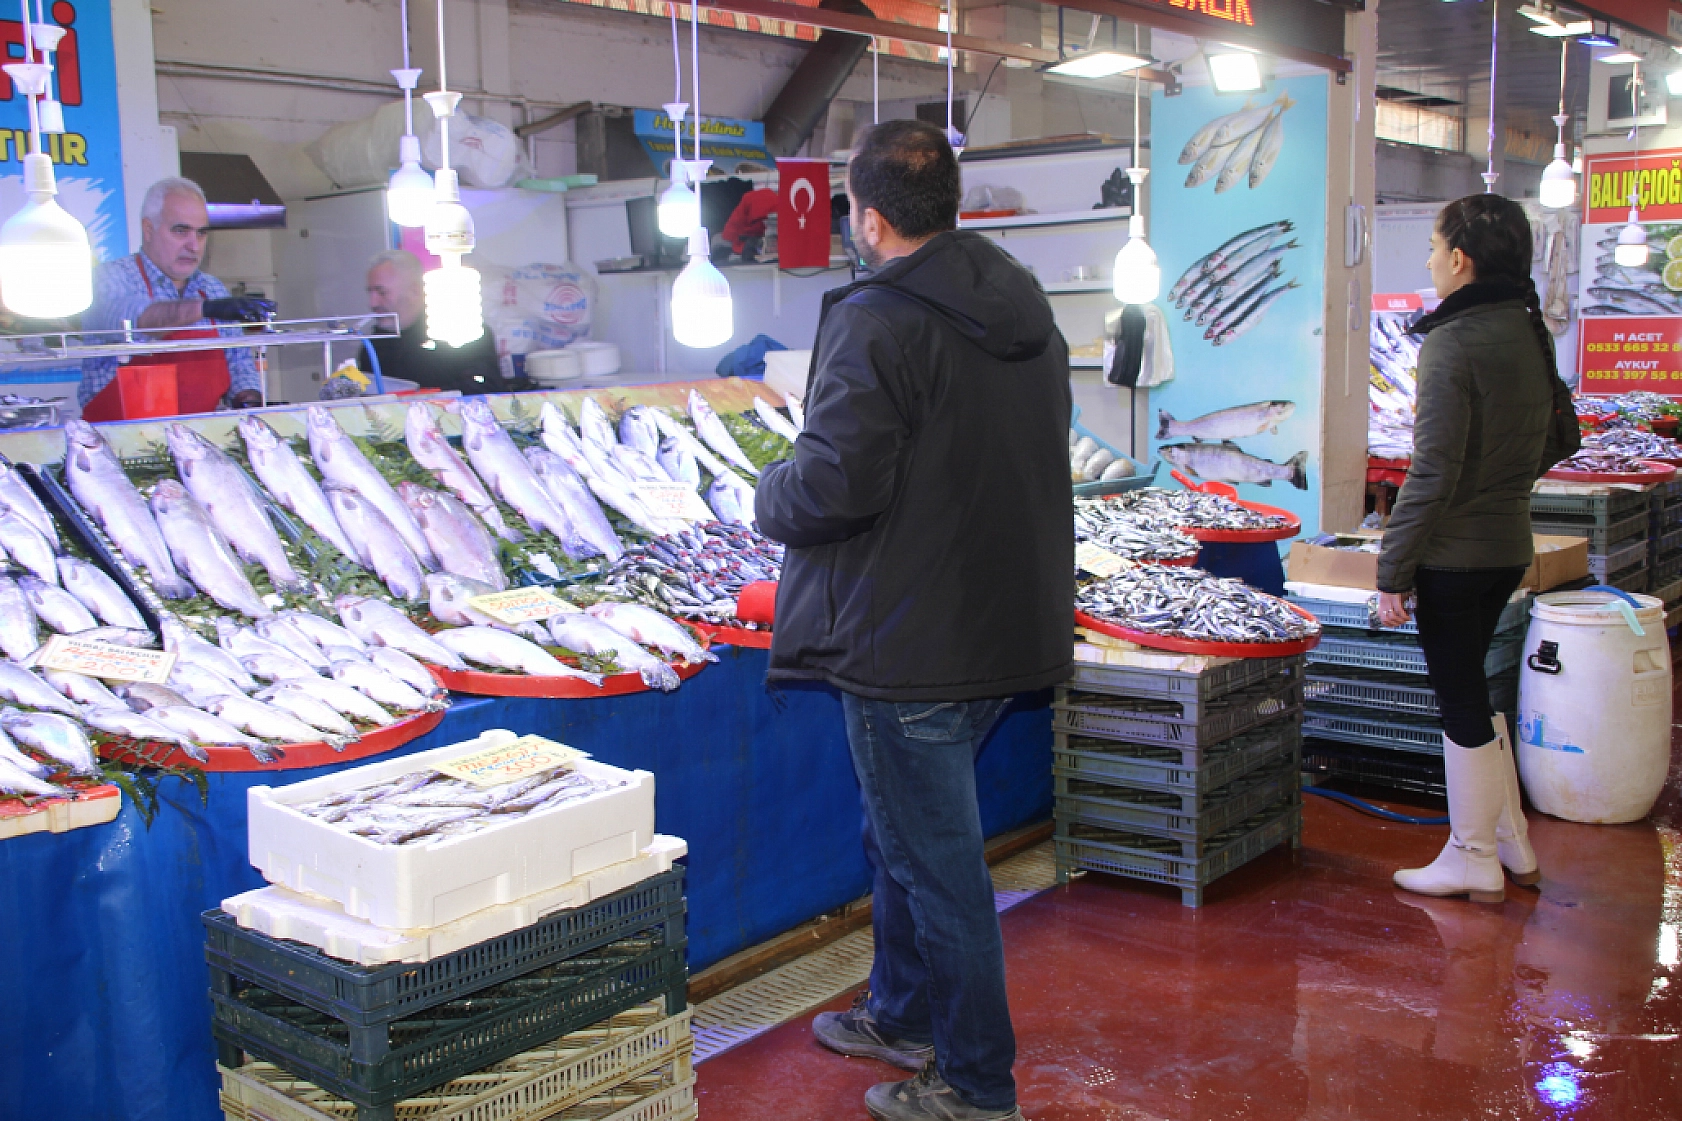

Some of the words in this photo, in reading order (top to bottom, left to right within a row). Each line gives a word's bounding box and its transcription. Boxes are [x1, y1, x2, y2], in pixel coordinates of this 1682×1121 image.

[1589, 160, 1682, 212] BALIKÇIOĞ
[1587, 343, 1620, 352] 0533
[1623, 343, 1649, 352] 665
[1652, 343, 1669, 352] 32
[1615, 361, 1660, 369] AYKUT
[1587, 371, 1619, 379] 0533
[1623, 371, 1647, 379] 397
[1651, 371, 1667, 379] 55
[1671, 371, 1682, 379] 6
[80, 661, 138, 676] 200
